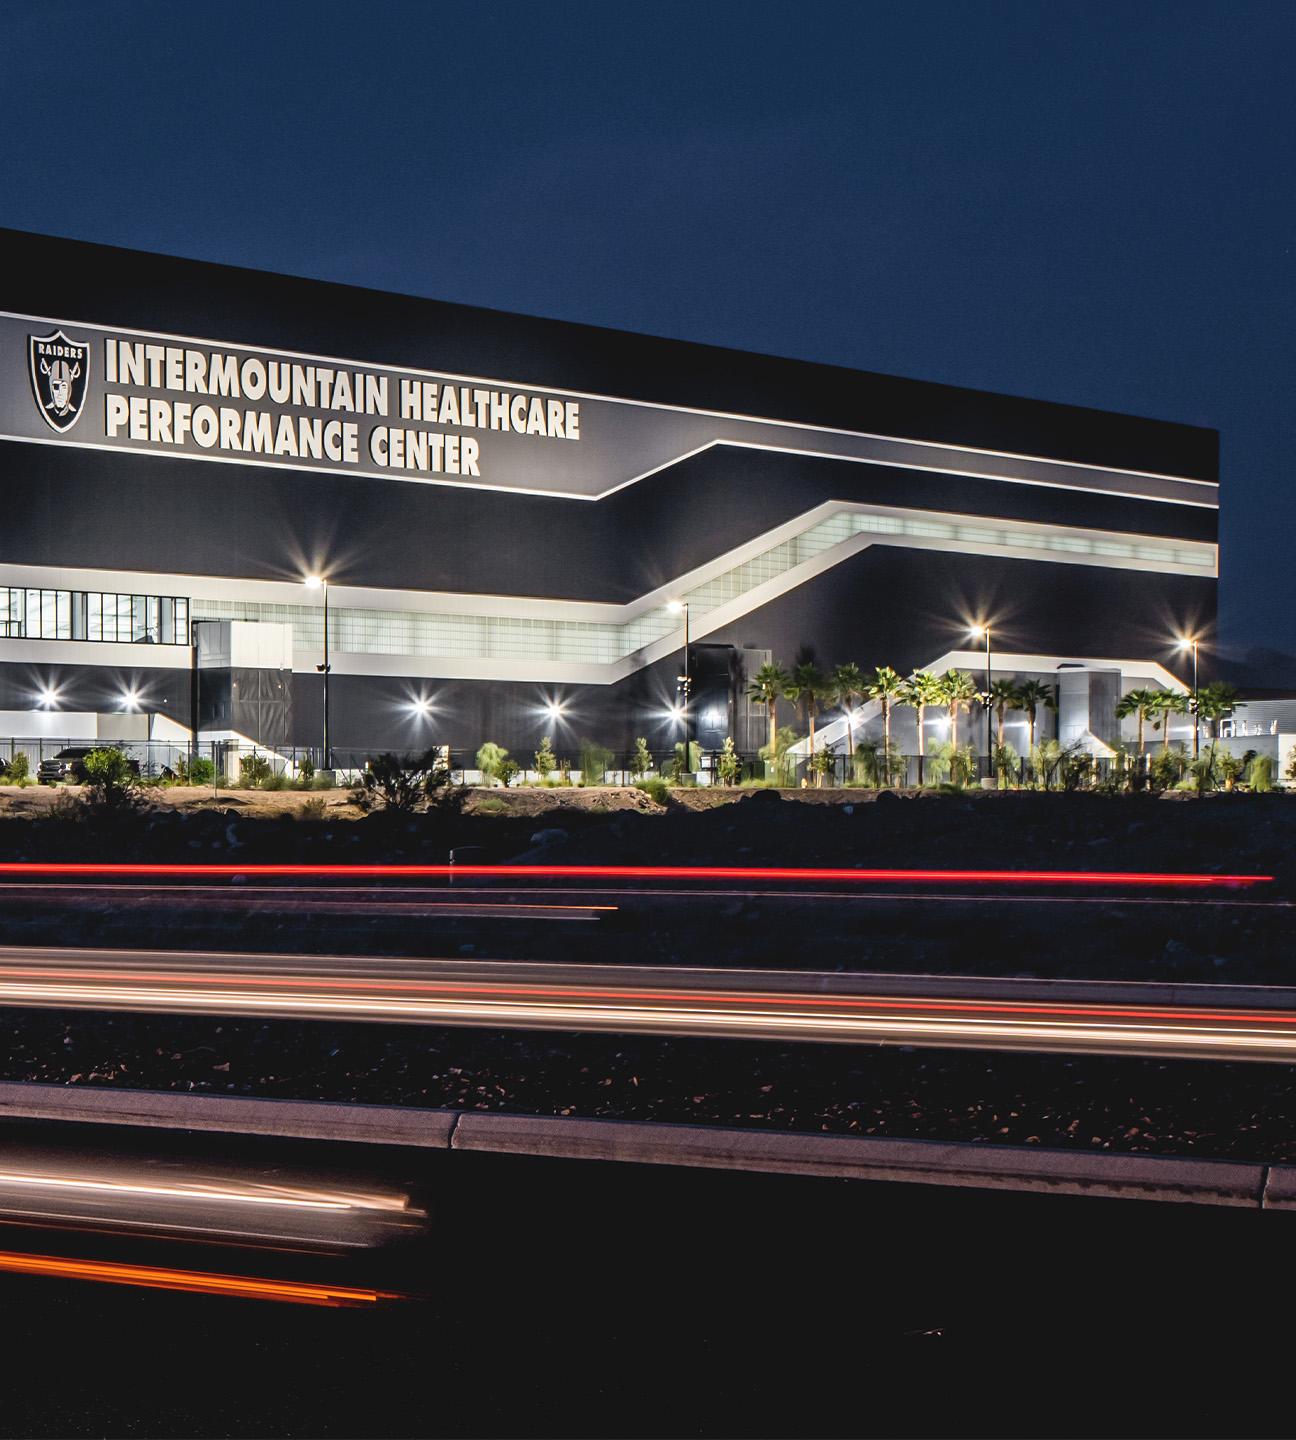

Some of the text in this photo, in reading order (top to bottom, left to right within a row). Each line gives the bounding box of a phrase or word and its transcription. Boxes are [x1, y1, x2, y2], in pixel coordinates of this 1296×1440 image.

[38, 343, 83, 359] RAIDERS
[106, 339, 580, 440] INTERMOUNTAIN HEALTHCARE
[106, 393, 480, 477] PERFORMANCE CENTER
